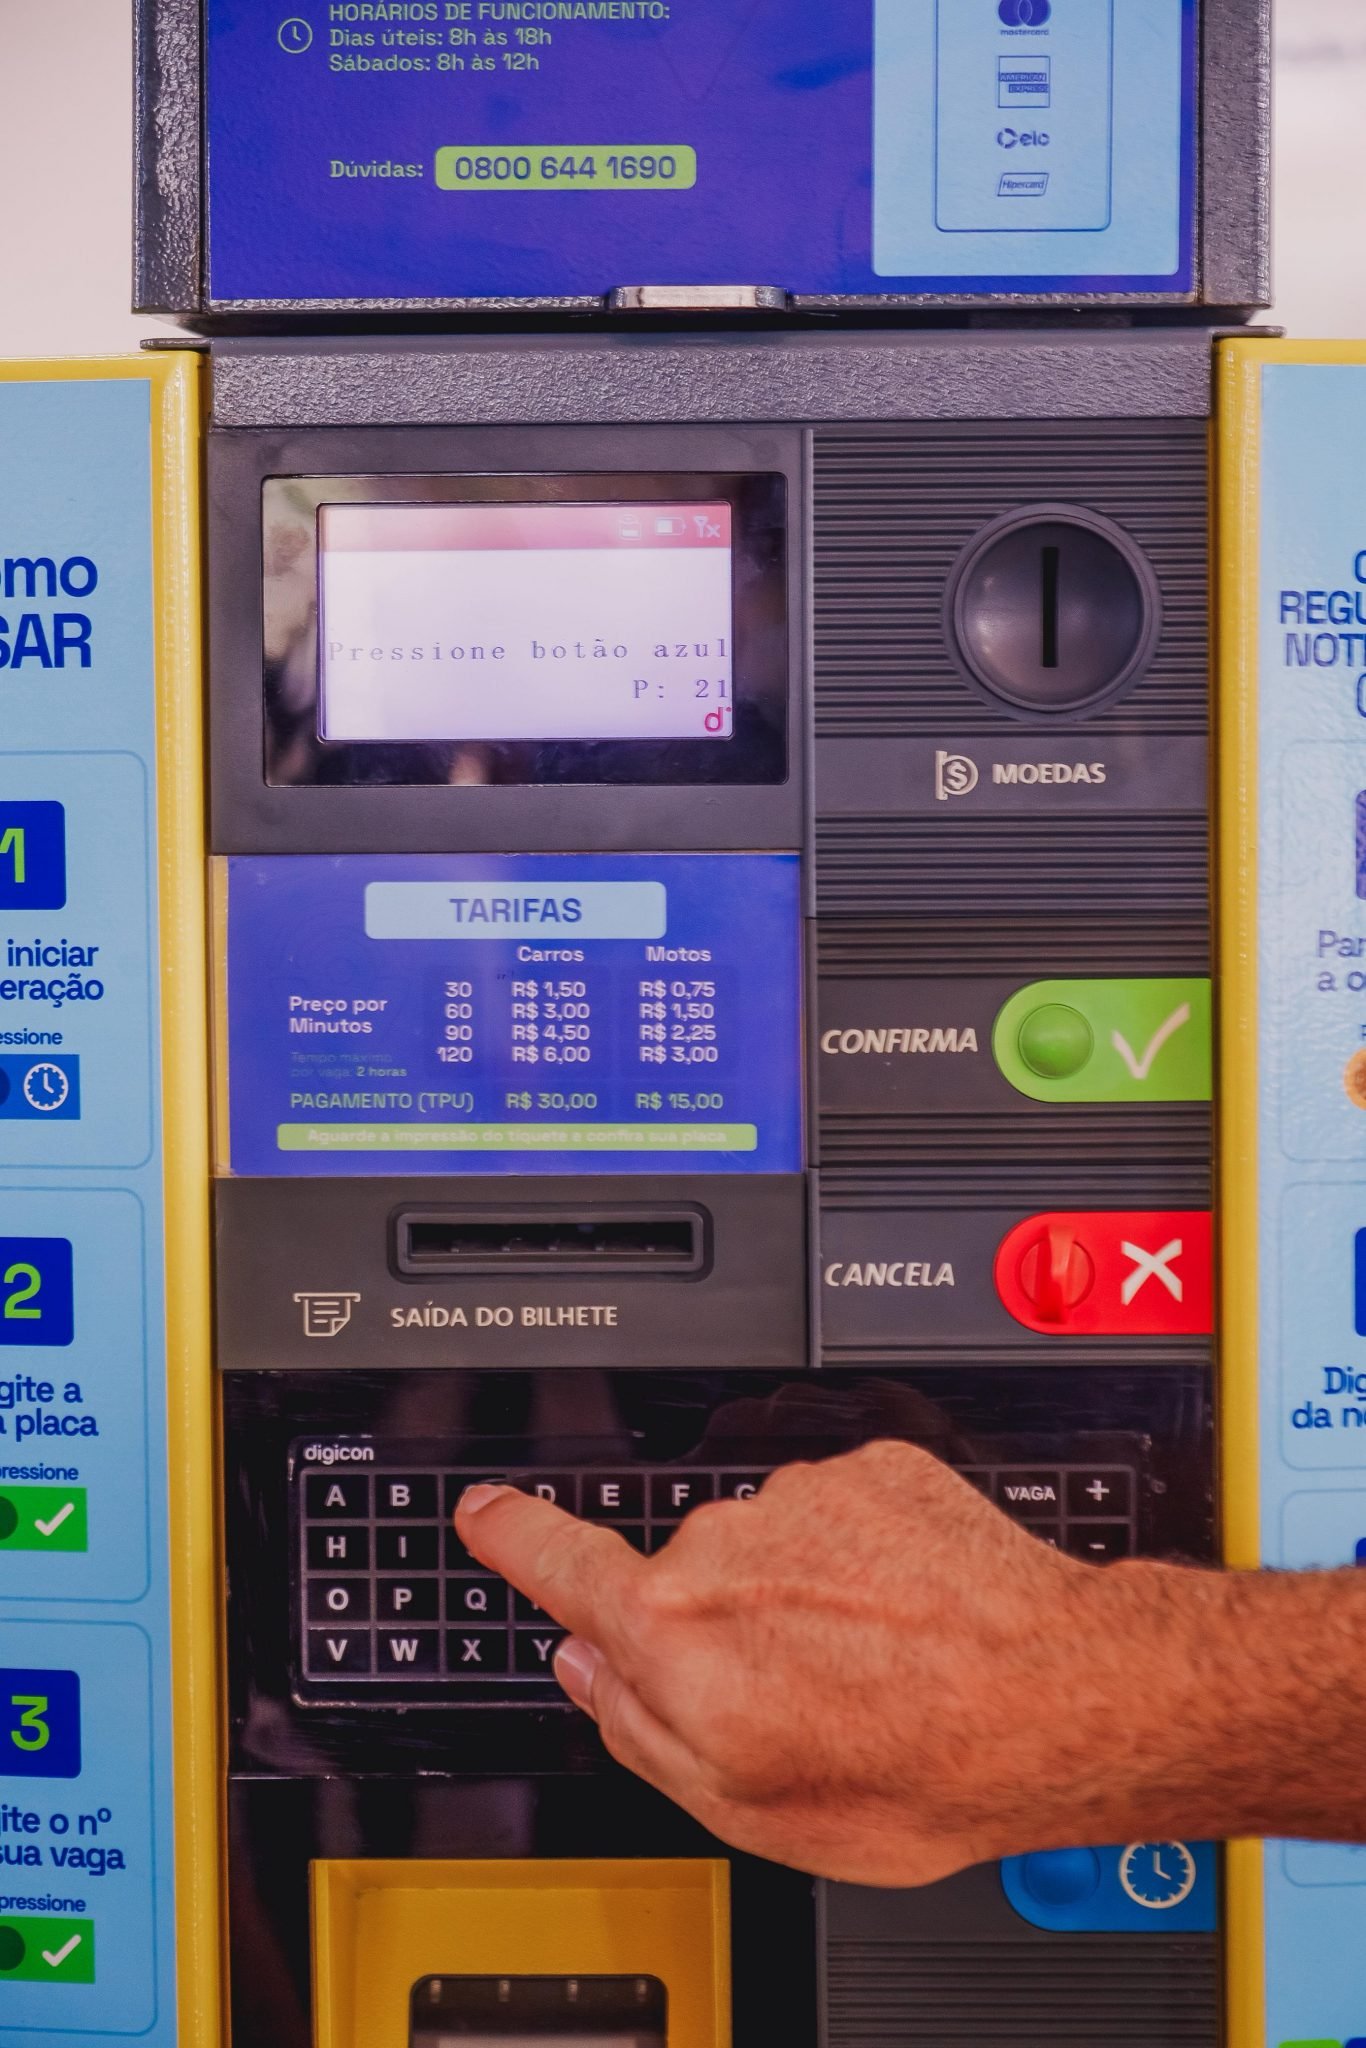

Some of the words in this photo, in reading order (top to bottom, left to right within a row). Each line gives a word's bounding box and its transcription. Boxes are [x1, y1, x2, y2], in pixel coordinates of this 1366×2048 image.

[329, 1, 438, 21] HORÁRIOS
[445, 3, 472, 20] DE
[478, 2, 670, 20] FUNCIONAMENTO:
[330, 29, 375, 47] Dias
[381, 28, 443, 46] úteis:
[449, 29, 477, 46] 8h
[483, 27, 509, 46] às
[515, 29, 552, 46] 18h
[329, 54, 431, 72] Sábados:
[436, 54, 465, 71] 8h
[471, 53, 496, 71] às
[502, 53, 540, 71] 12h
[999, 73, 1047, 82] AMERICAN
[330, 159, 424, 178] Dúvidas:
[455, 156, 531, 180] 0800
[540, 156, 597, 180] 644
[606, 155, 677, 180] 1690
[1002, 180, 1045, 192] Hipercard
[0, 556, 98, 598] mo
[329, 640, 507, 662] Pressione
[531, 638, 630, 660] botão
[654, 638, 728, 660] azul
[1285, 632, 1366, 668] NOT
[633, 679, 666, 700] P:
[694, 678, 729, 699] 21
[992, 763, 1107, 785] MOEDAS
[449, 897, 583, 924] TARIFAS
[7, 938, 99, 967] iniciar
[516, 945, 585, 963] Carros
[645, 945, 712, 963] Motos
[0, 972, 104, 1008] eração
[445, 980, 473, 998] 30
[511, 979, 539, 999] R$
[543, 980, 587, 1000] 1,50
[639, 979, 667, 999] R$
[670, 980, 717, 1000] 0,75
[1317, 970, 1338, 992] a
[289, 996, 348, 1015] Preço
[352, 1000, 388, 1015] por
[444, 1002, 473, 1019] 60
[511, 1001, 539, 1021] R$
[543, 1002, 591, 1021] 3,00
[639, 1001, 667, 1021] R$
[670, 1002, 715, 1021] 1,50
[289, 1018, 373, 1034] Minutos
[444, 1024, 473, 1041] 90
[511, 1023, 539, 1042] R$
[543, 1024, 591, 1043] 4,50
[639, 1023, 667, 1042] R$
[670, 1024, 717, 1043] 2,25
[820, 1027, 979, 1055] CONFIRMA
[436, 1046, 473, 1063] 120
[511, 1045, 539, 1064] R$
[543, 1046, 591, 1065] 6,00
[639, 1045, 667, 1064] R$
[670, 1046, 719, 1065] 3,00
[355, 1066, 366, 1077] 2
[368, 1066, 408, 1077] horas
[290, 1092, 413, 1109] PAGAMENTO
[418, 1091, 475, 1113] (TPU)
[506, 1091, 533, 1111] R$
[537, 1092, 598, 1112] 30,00
[635, 1091, 663, 1111] R$
[668, 1092, 724, 1112] 15,00
[308, 1129, 377, 1145] Aguarde
[380, 1132, 391, 1143] a
[394, 1128, 478, 1145] impressão
[482, 1129, 504, 1143] do
[571, 1132, 583, 1143] e
[586, 1129, 644, 1143] confira
[650, 1132, 677, 1143] sua
[682, 1129, 727, 1145] placa
[824, 1261, 956, 1288] CANCELA
[4, 1263, 42, 1319] 2
[391, 1300, 468, 1327] SAÍDA
[476, 1306, 514, 1327] DO
[520, 1305, 619, 1327] BILHETE
[63, 1382, 84, 1404] a
[15, 1407, 100, 1442] placa
[1292, 1401, 1334, 1429] da
[304, 1443, 375, 1466] digicon
[0, 1462, 79, 1482] ressione
[324, 1485, 347, 1508] A
[390, 1485, 412, 1508] B
[601, 1484, 621, 1508] E
[671, 1483, 691, 1508] F
[1004, 1485, 1057, 1502] VAGA
[327, 1536, 347, 1559] H
[399, 1536, 409, 1559] I
[327, 1587, 350, 1611] O
[394, 1588, 414, 1611] P
[465, 1588, 488, 1612] Q
[327, 1639, 349, 1662] V
[391, 1638, 419, 1662] W
[461, 1638, 483, 1662] X
[531, 1638, 554, 1662] Y
[11, 1695, 50, 1751] 3
[0, 1804, 41, 1834] ite
[49, 1813, 69, 1835] o
[0, 1844, 43, 1867] ua
[49, 1846, 127, 1877] vaga
[0, 1893, 86, 1913] pressione
